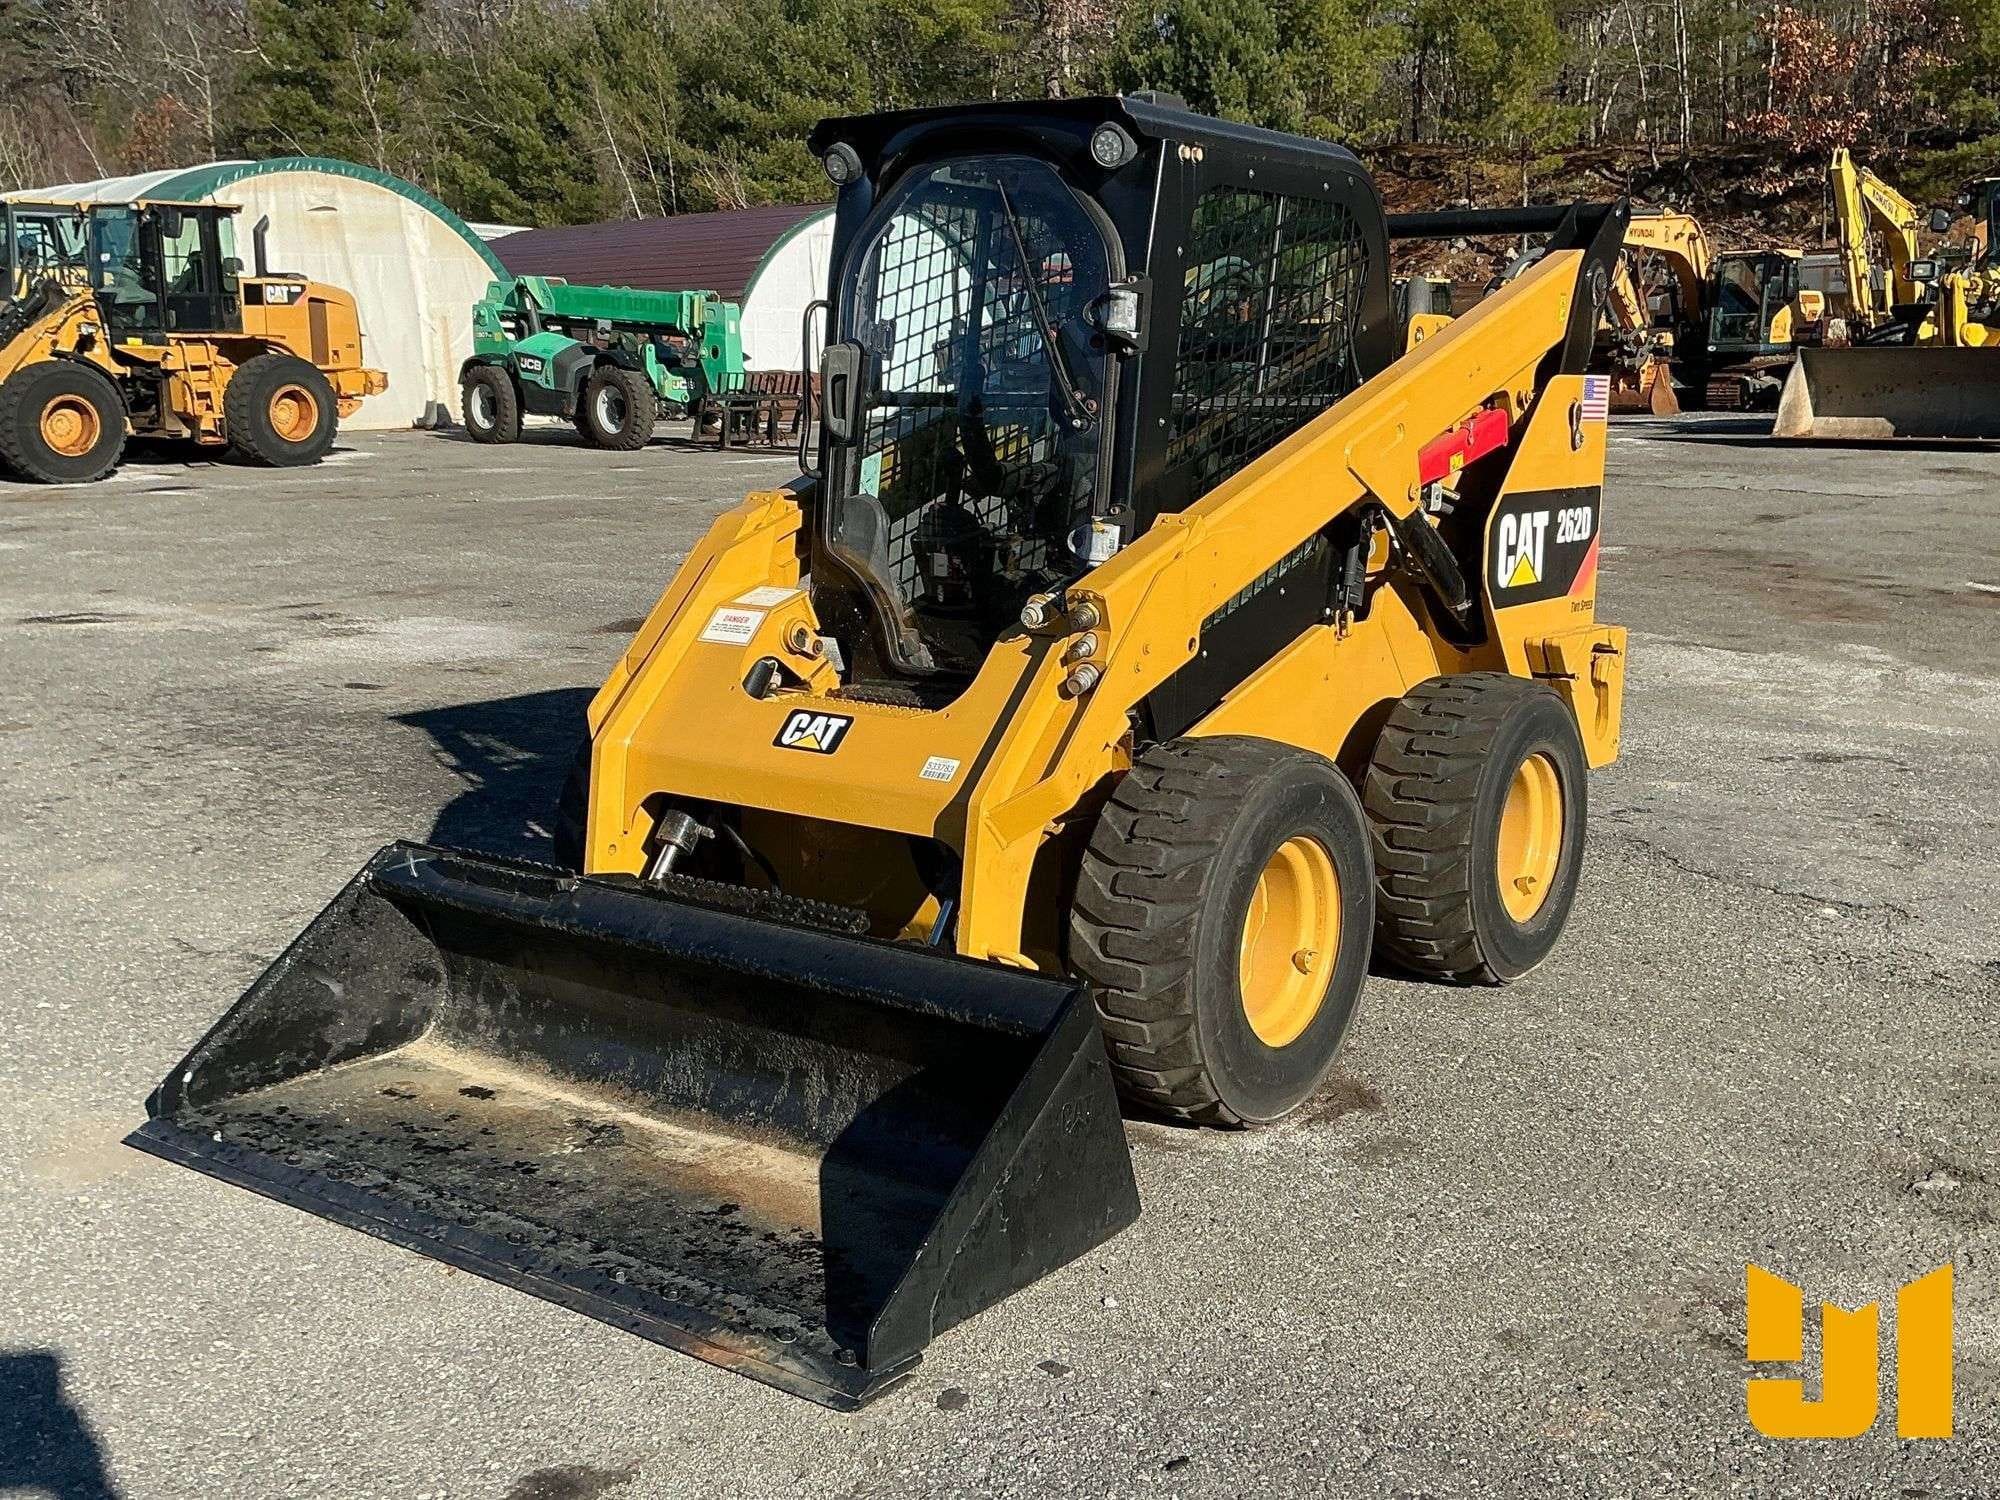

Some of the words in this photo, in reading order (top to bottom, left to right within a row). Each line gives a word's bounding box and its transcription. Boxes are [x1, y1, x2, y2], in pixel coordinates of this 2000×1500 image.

[266, 285, 289, 304] CAT
[520, 357, 542, 372] JCB
[1498, 511, 1550, 588] CAT
[1556, 507, 1591, 543] 262D
[722, 614, 750, 624] DANGER
[781, 713, 848, 751] CAT
